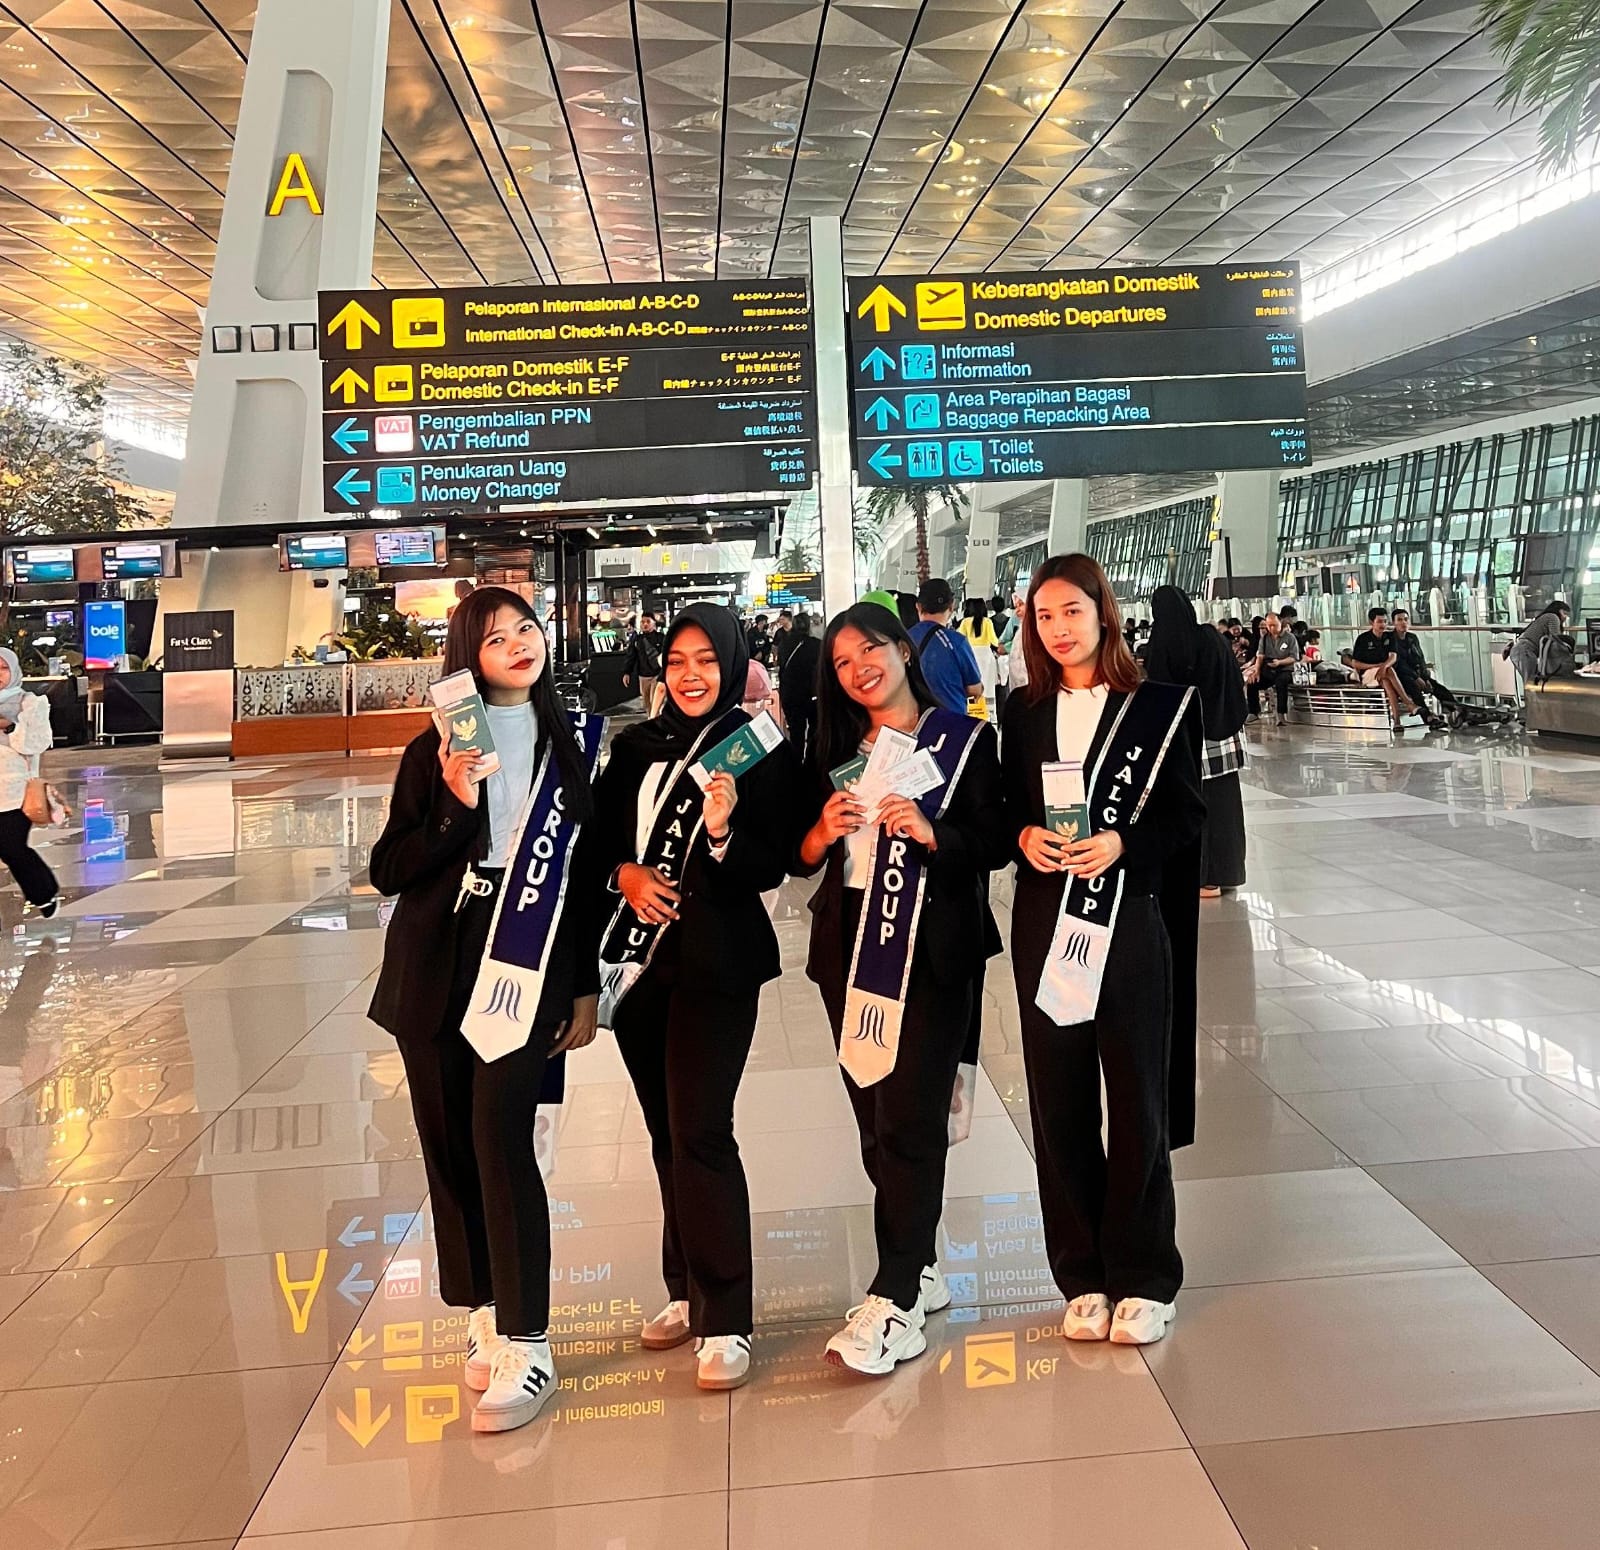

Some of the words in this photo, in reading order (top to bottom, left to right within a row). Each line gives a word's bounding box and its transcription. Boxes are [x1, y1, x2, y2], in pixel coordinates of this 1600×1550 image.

[268, 152, 322, 216] A
[972, 278, 1109, 300] Keberangkatan
[1113, 273, 1200, 294] Domestik
[465, 303, 539, 317] Pelaporan
[542, 295, 636, 312] Internasional
[638, 294, 700, 310] A-B-C-D
[974, 309, 1061, 330] Domestic
[1066, 306, 1166, 327] Departures
[466, 326, 556, 343] International
[560, 322, 624, 341] Check-in
[626, 321, 687, 338] A-B-C-D
[941, 342, 1016, 359] Informasi
[421, 363, 508, 382] Pelaporan
[512, 358, 594, 377] Domestik
[598, 356, 630, 373] E-F
[942, 361, 1032, 379] Information
[421, 383, 502, 400] Domestic
[506, 379, 583, 398] Check-in
[588, 378, 620, 394] E-F
[946, 391, 985, 408] Area
[989, 388, 1071, 408] Perapihan
[1075, 385, 1131, 405] Bagasi
[381, 419, 407, 432] VAT
[419, 411, 546, 433] Pengembalian
[551, 407, 592, 425] PPN
[946, 410, 1019, 430] Baggage
[1024, 406, 1109, 427] Repacking
[1111, 405, 1151, 421] Area
[421, 434, 460, 451] VAT
[466, 431, 530, 449] Refund
[988, 438, 1034, 455] Toilet
[989, 457, 1044, 475] Toilets
[1283, 452, 1306, 462] トイレ
[421, 463, 514, 481] Penukaran
[519, 459, 567, 478] Uang
[422, 485, 481, 502] Money
[485, 480, 562, 498] Changer
